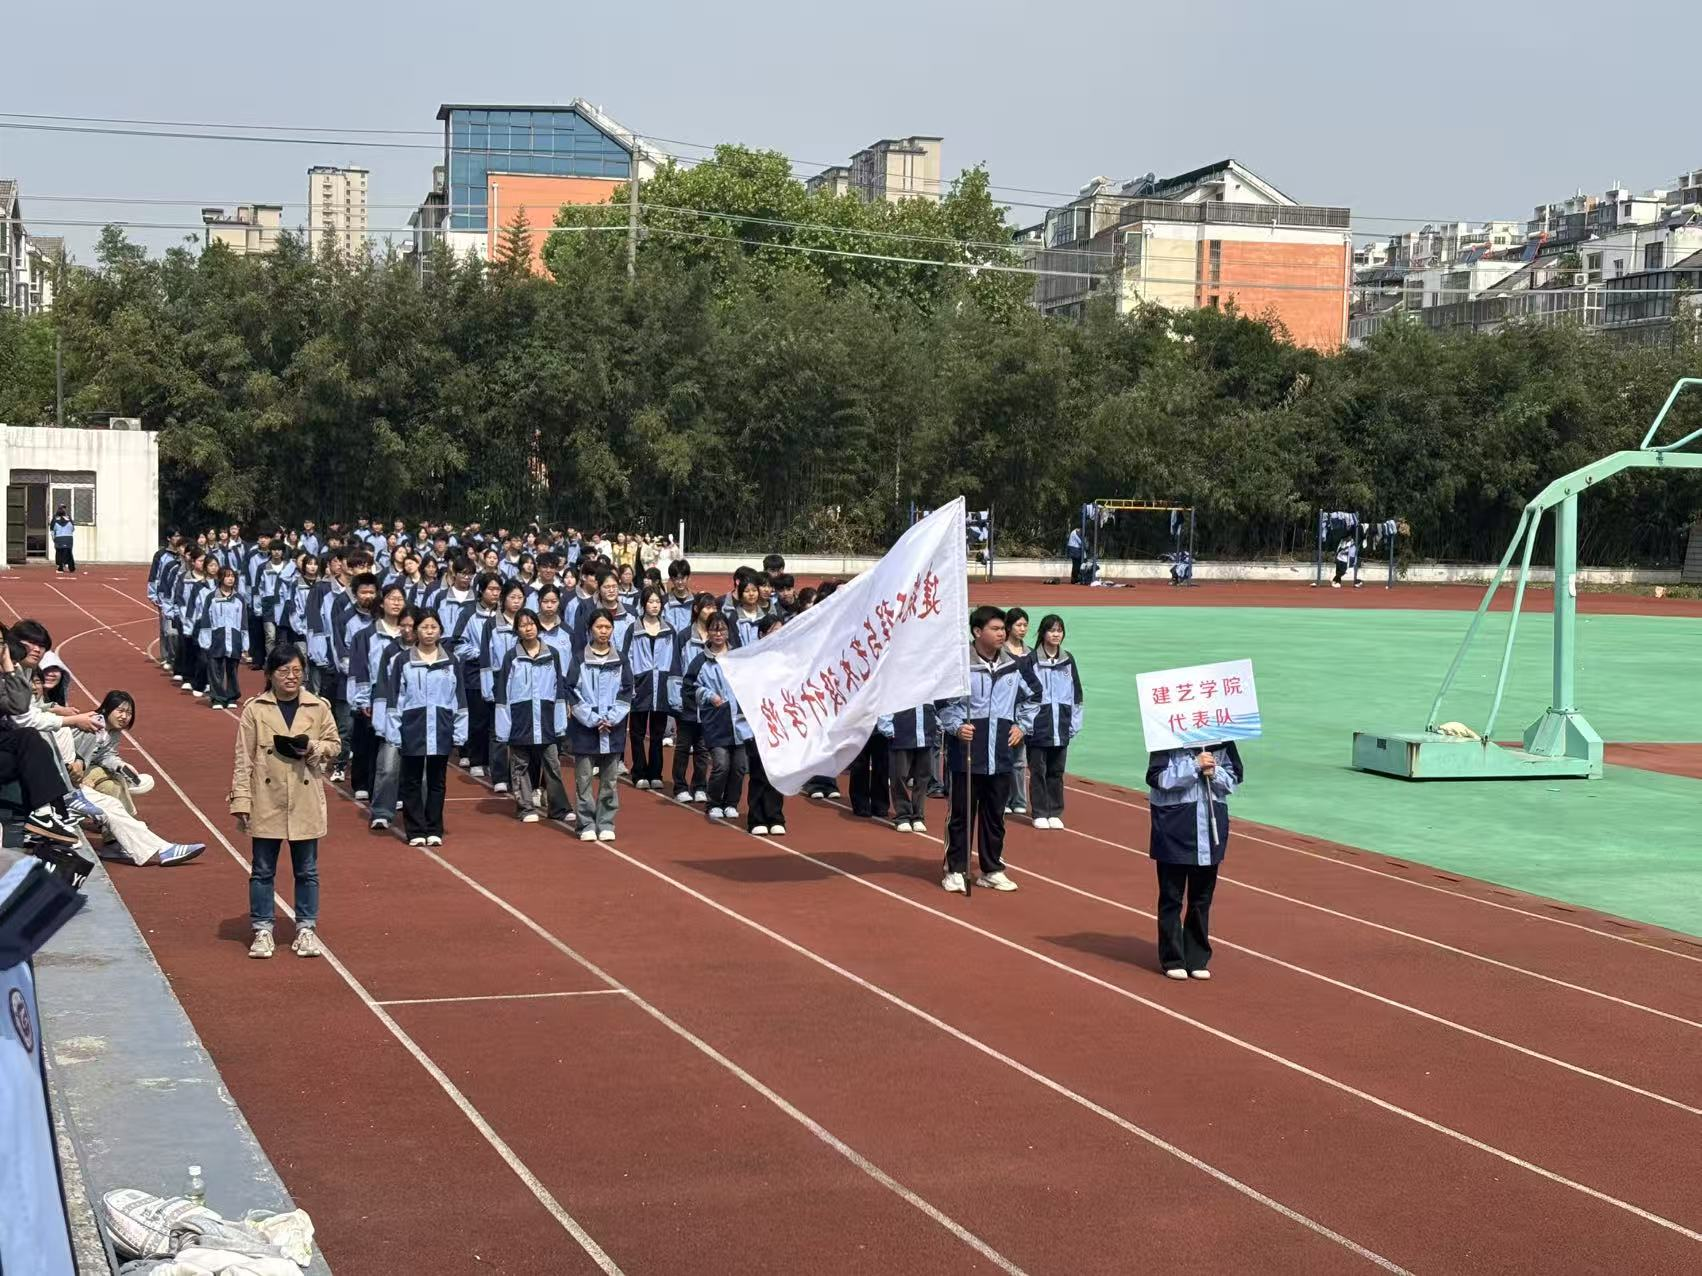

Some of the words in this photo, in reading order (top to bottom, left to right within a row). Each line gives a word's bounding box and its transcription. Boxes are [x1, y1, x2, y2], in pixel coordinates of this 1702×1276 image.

[1152, 676, 1243, 705] 建艺学院
[1168, 707, 1236, 733] 代表队
